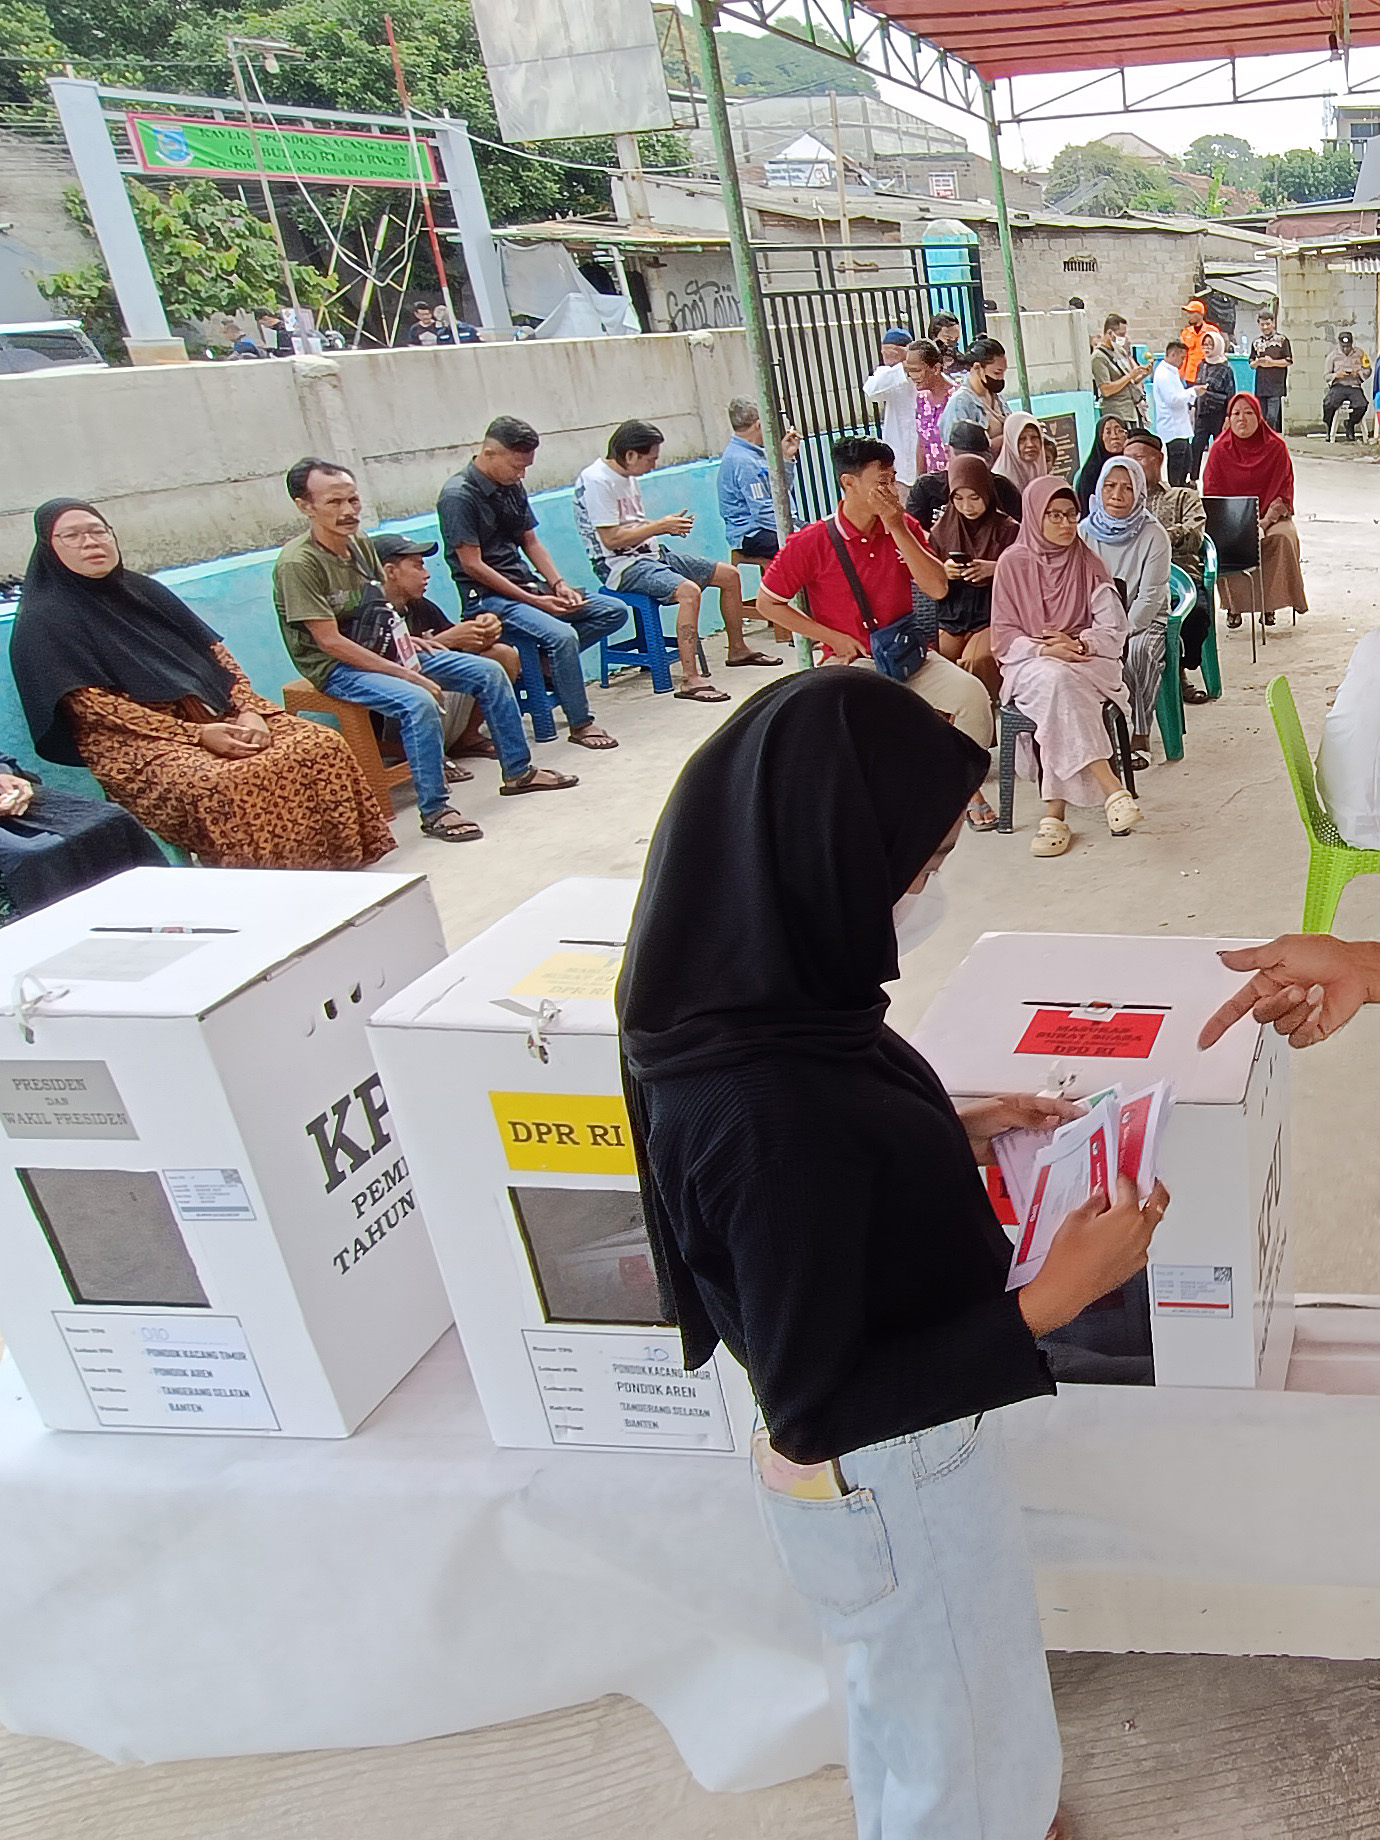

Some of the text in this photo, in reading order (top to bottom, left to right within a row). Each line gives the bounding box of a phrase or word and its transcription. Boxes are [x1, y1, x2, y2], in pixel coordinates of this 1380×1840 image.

[343, 153, 364, 164] 004
[393, 157, 406, 167] 02
[11, 1078, 88, 1091] PRESIDEN
[2, 1112, 129, 1125] WAKIL PRESIDEN
[507, 1120, 626, 1147] DPR RI
[333, 1189, 415, 1275] TAHUN
[616, 1381, 697, 1398] PONDOK AREN
